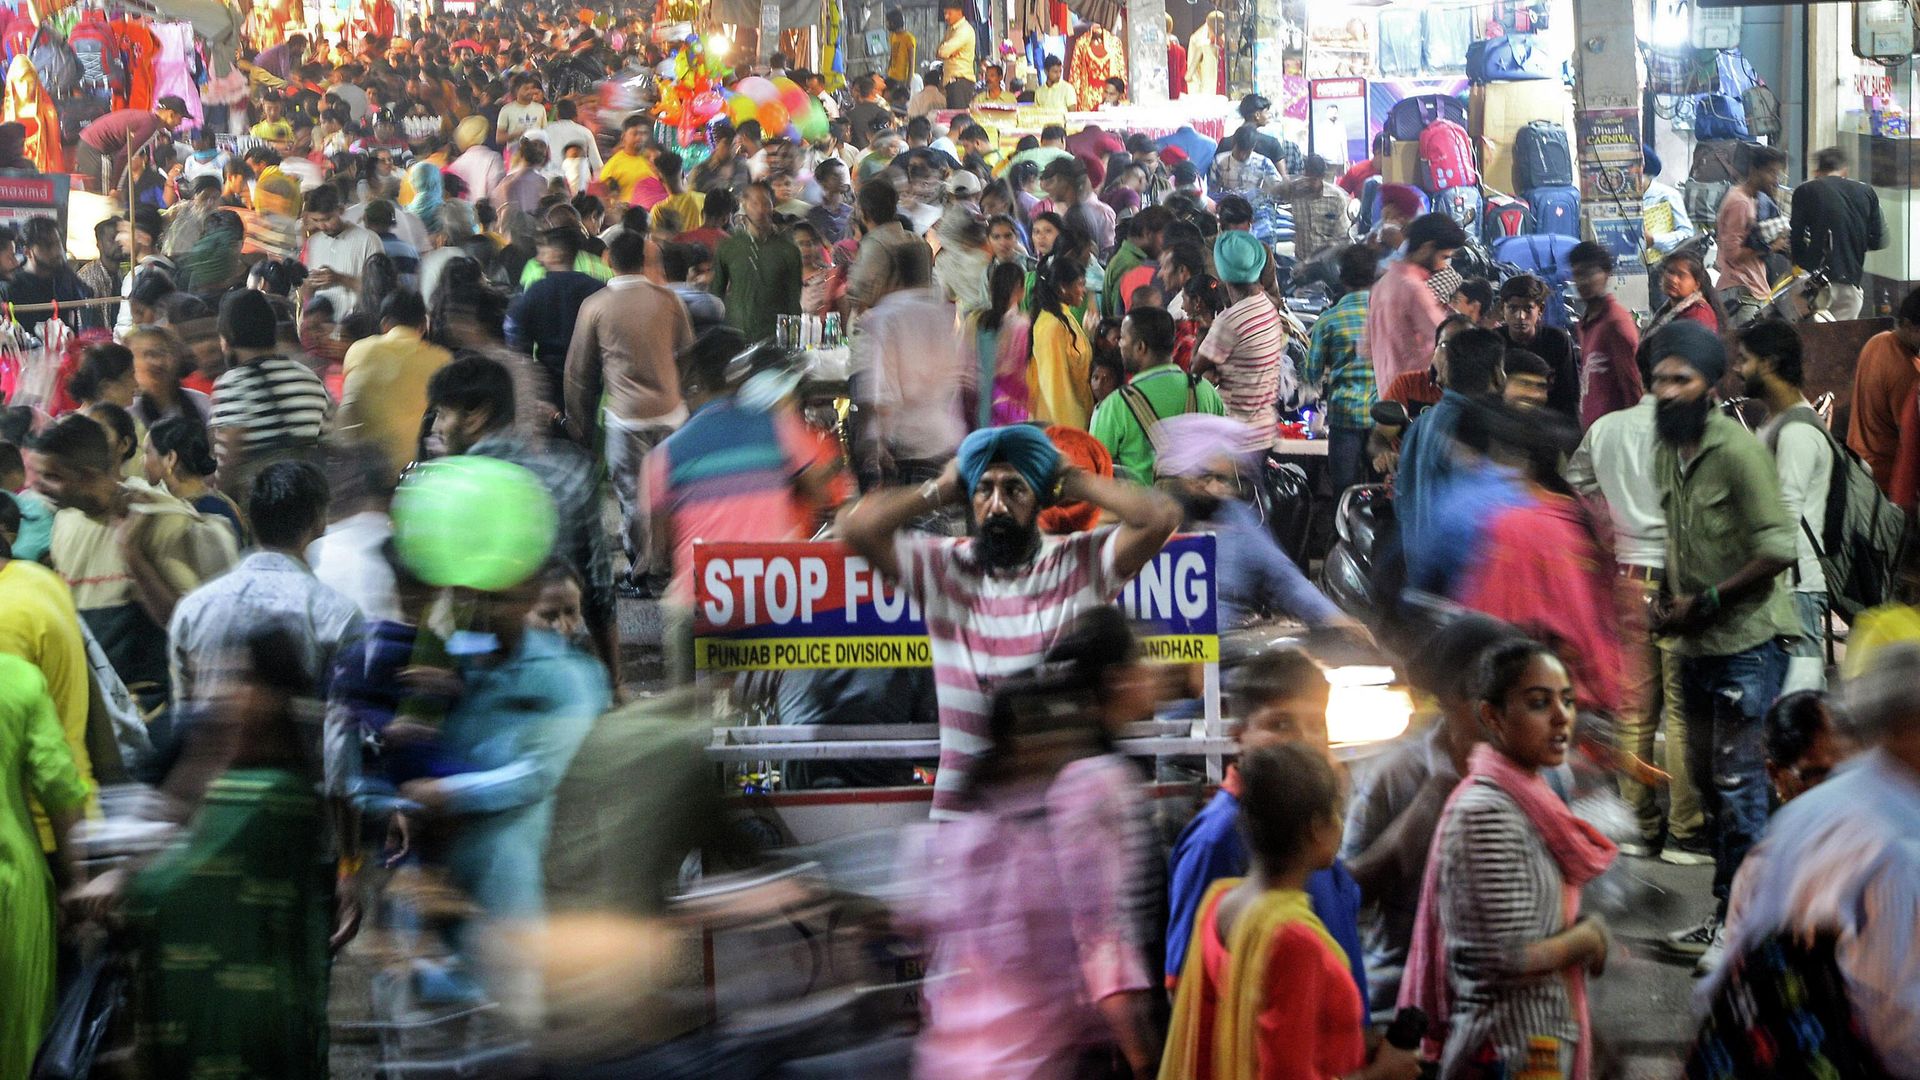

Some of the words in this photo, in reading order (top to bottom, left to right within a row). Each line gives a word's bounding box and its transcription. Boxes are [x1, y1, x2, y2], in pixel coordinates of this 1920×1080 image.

[1591, 124, 1625, 135] Diwali
[1586, 134, 1635, 145] CARNIVAL
[0, 184, 48, 200] maxima
[704, 556, 829, 625] STOP
[844, 556, 922, 623] FO
[1114, 551, 1208, 620] ING
[707, 644, 770, 666] PUNJAB
[775, 643, 831, 664] POLICE
[836, 641, 901, 663] DIVISION
[906, 642, 933, 662] NO.
